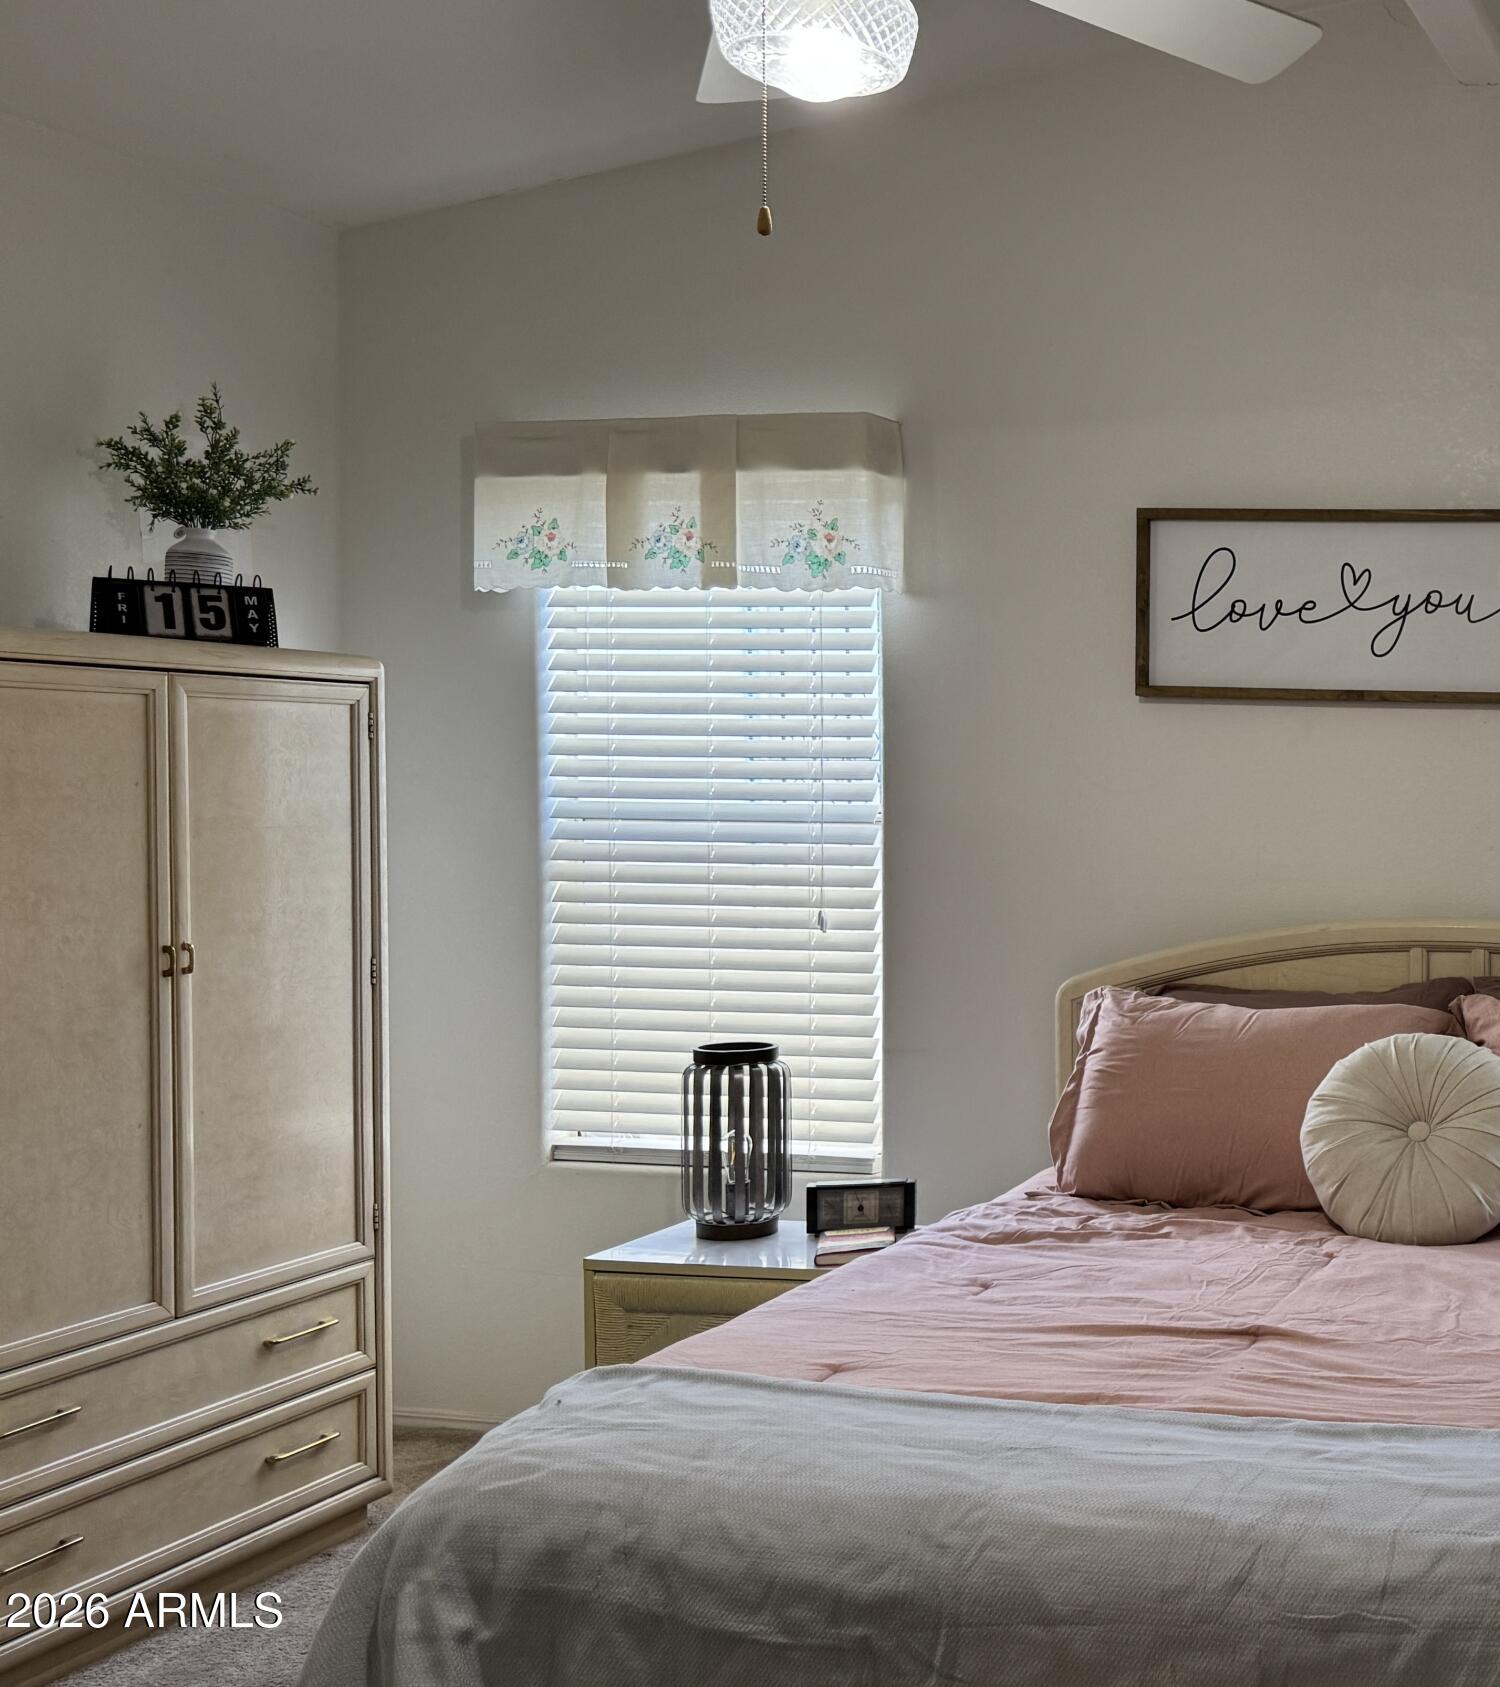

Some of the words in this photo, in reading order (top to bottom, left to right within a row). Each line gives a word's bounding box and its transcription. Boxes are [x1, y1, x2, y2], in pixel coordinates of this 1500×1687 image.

[117, 592, 128, 625] FRI
[244, 595, 260, 634] MAY
[1171, 546, 1326, 633] love
[1371, 586, 1484, 659] you
